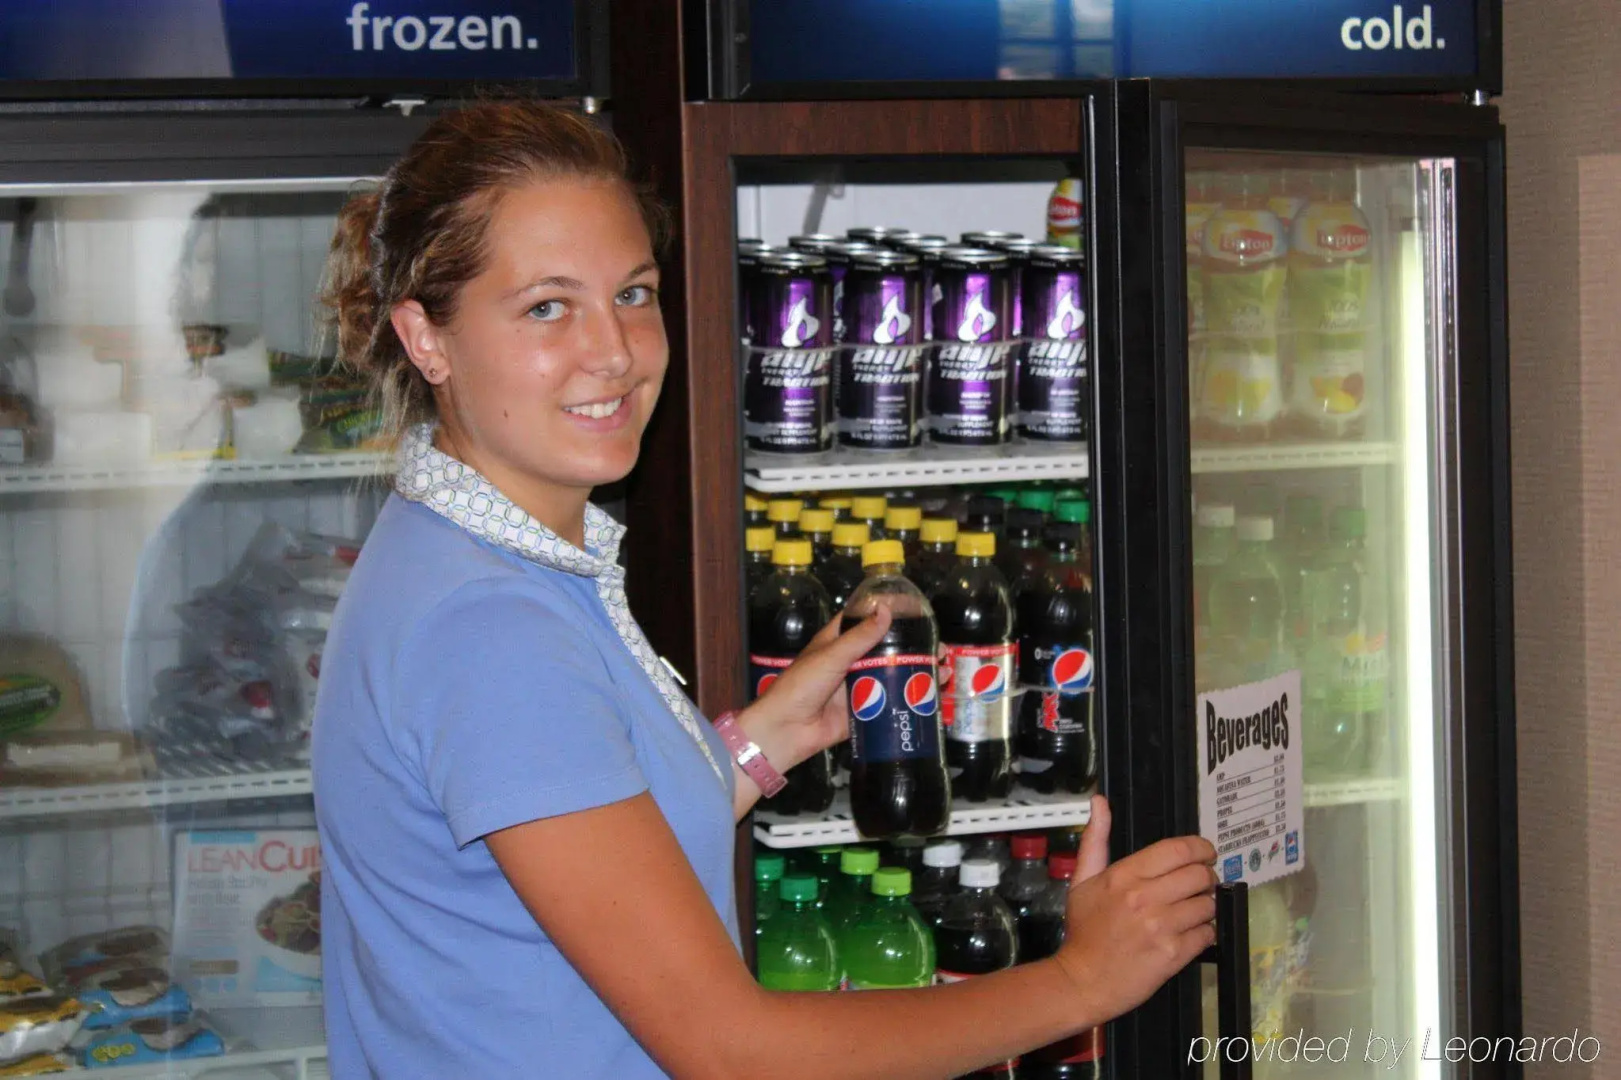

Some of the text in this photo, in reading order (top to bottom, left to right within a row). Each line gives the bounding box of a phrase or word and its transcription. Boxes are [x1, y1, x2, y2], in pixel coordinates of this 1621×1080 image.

[346, 2, 538, 50] frozen.
[1341, 4, 1445, 50] cold.
[892, 708, 914, 752] pepsi
[1206, 691, 1290, 776] Beverages
